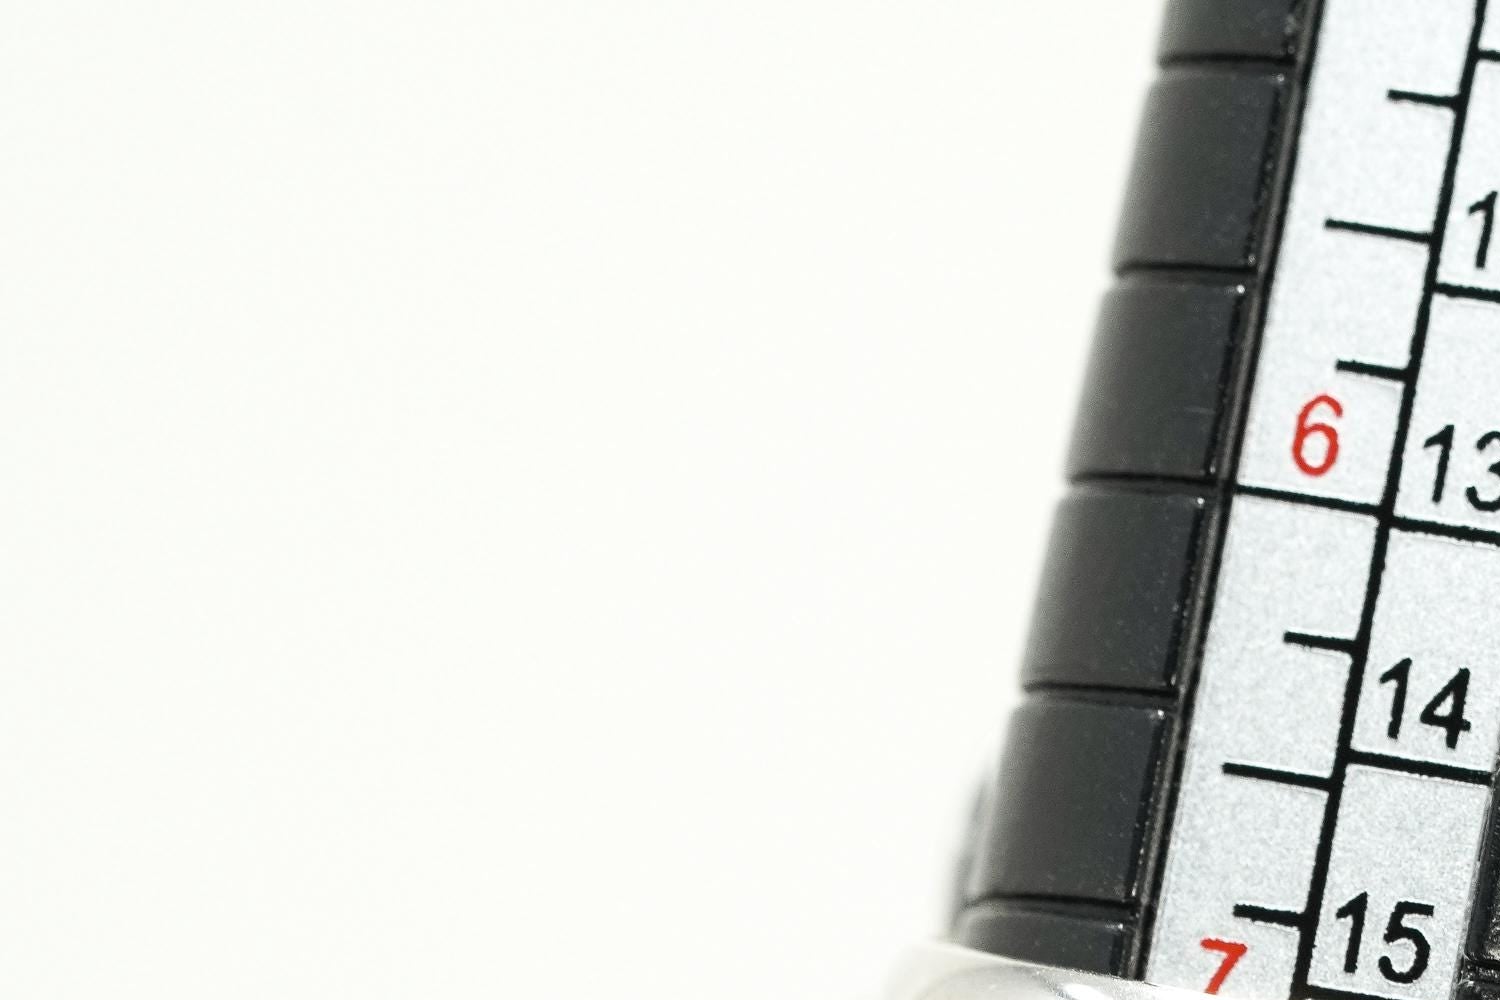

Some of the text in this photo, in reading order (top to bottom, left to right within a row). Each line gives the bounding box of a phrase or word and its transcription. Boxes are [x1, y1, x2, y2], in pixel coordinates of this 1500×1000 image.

[1292, 395, 1343, 476] 6
[1379, 657, 1472, 749] 14
[1200, 938, 1248, 995] 7
[1335, 891, 1435, 984] 15
